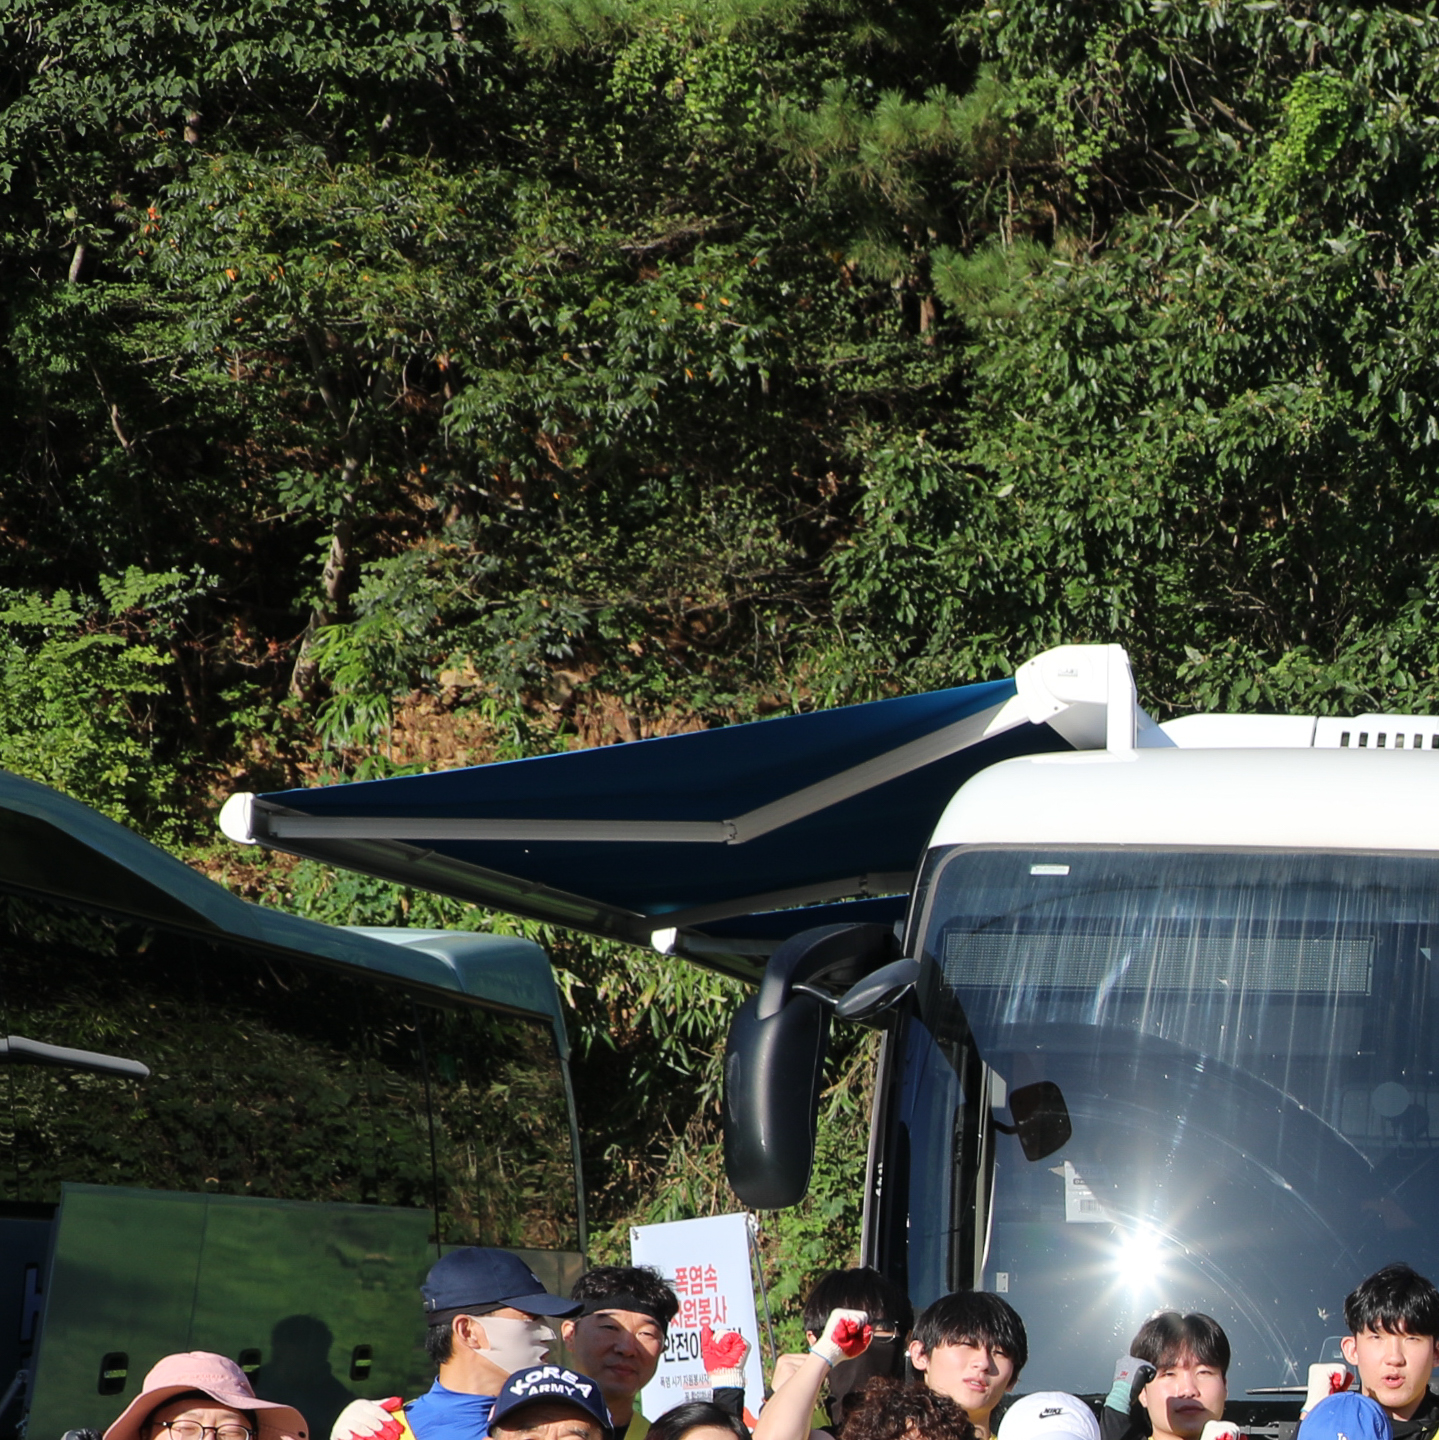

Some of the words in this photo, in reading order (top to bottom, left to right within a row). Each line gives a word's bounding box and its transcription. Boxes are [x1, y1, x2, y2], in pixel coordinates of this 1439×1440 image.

[675, 1264, 718, 1296] 폭염속
[510, 1366, 593, 1399] KOREA
[529, 1382, 577, 1397] ARMY
[1043, 1407, 1063, 1415] NIKE
